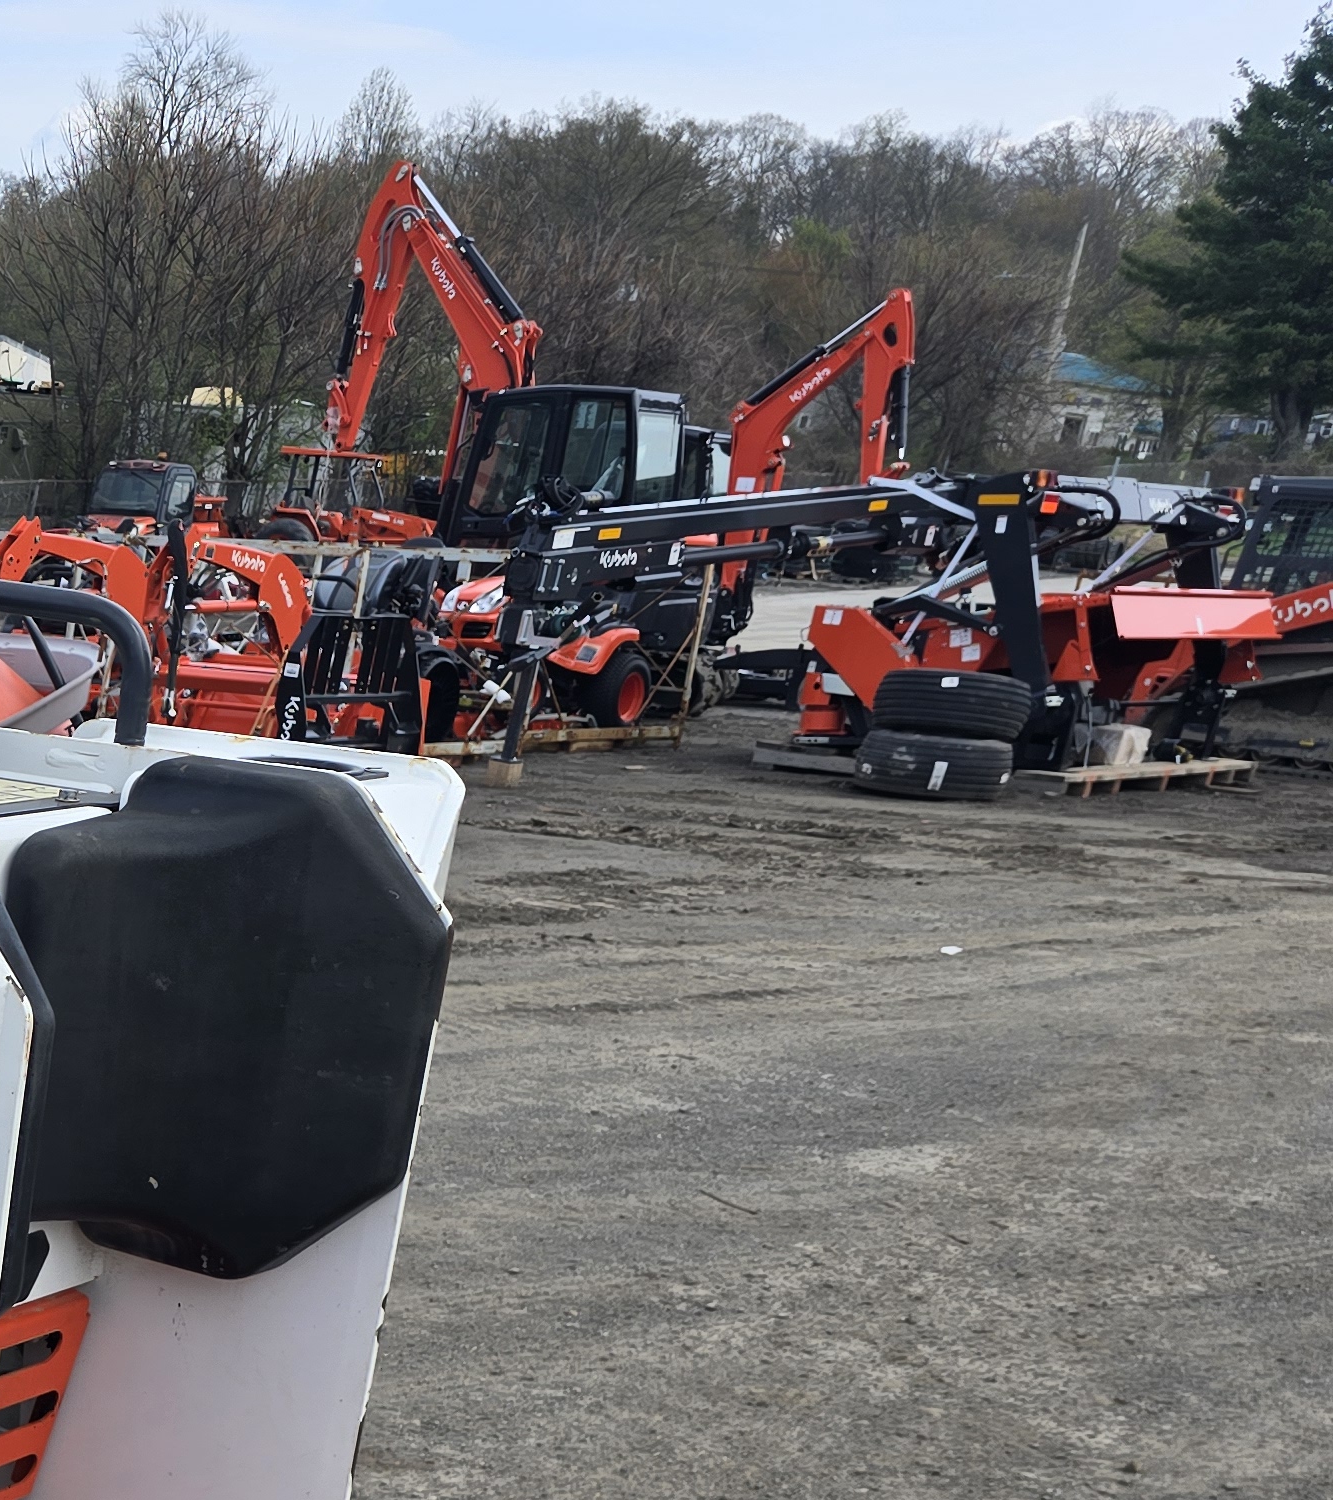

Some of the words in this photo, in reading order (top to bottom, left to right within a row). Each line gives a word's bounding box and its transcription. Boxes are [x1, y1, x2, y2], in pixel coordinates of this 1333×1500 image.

[431, 256, 456, 300] Kubota
[789, 367, 831, 403] Kubota
[231, 549, 266, 573] Kubota
[599, 548, 638, 569] Kubota
[1271, 588, 1333, 626] ubo
[280, 696, 301, 740] Kubo
